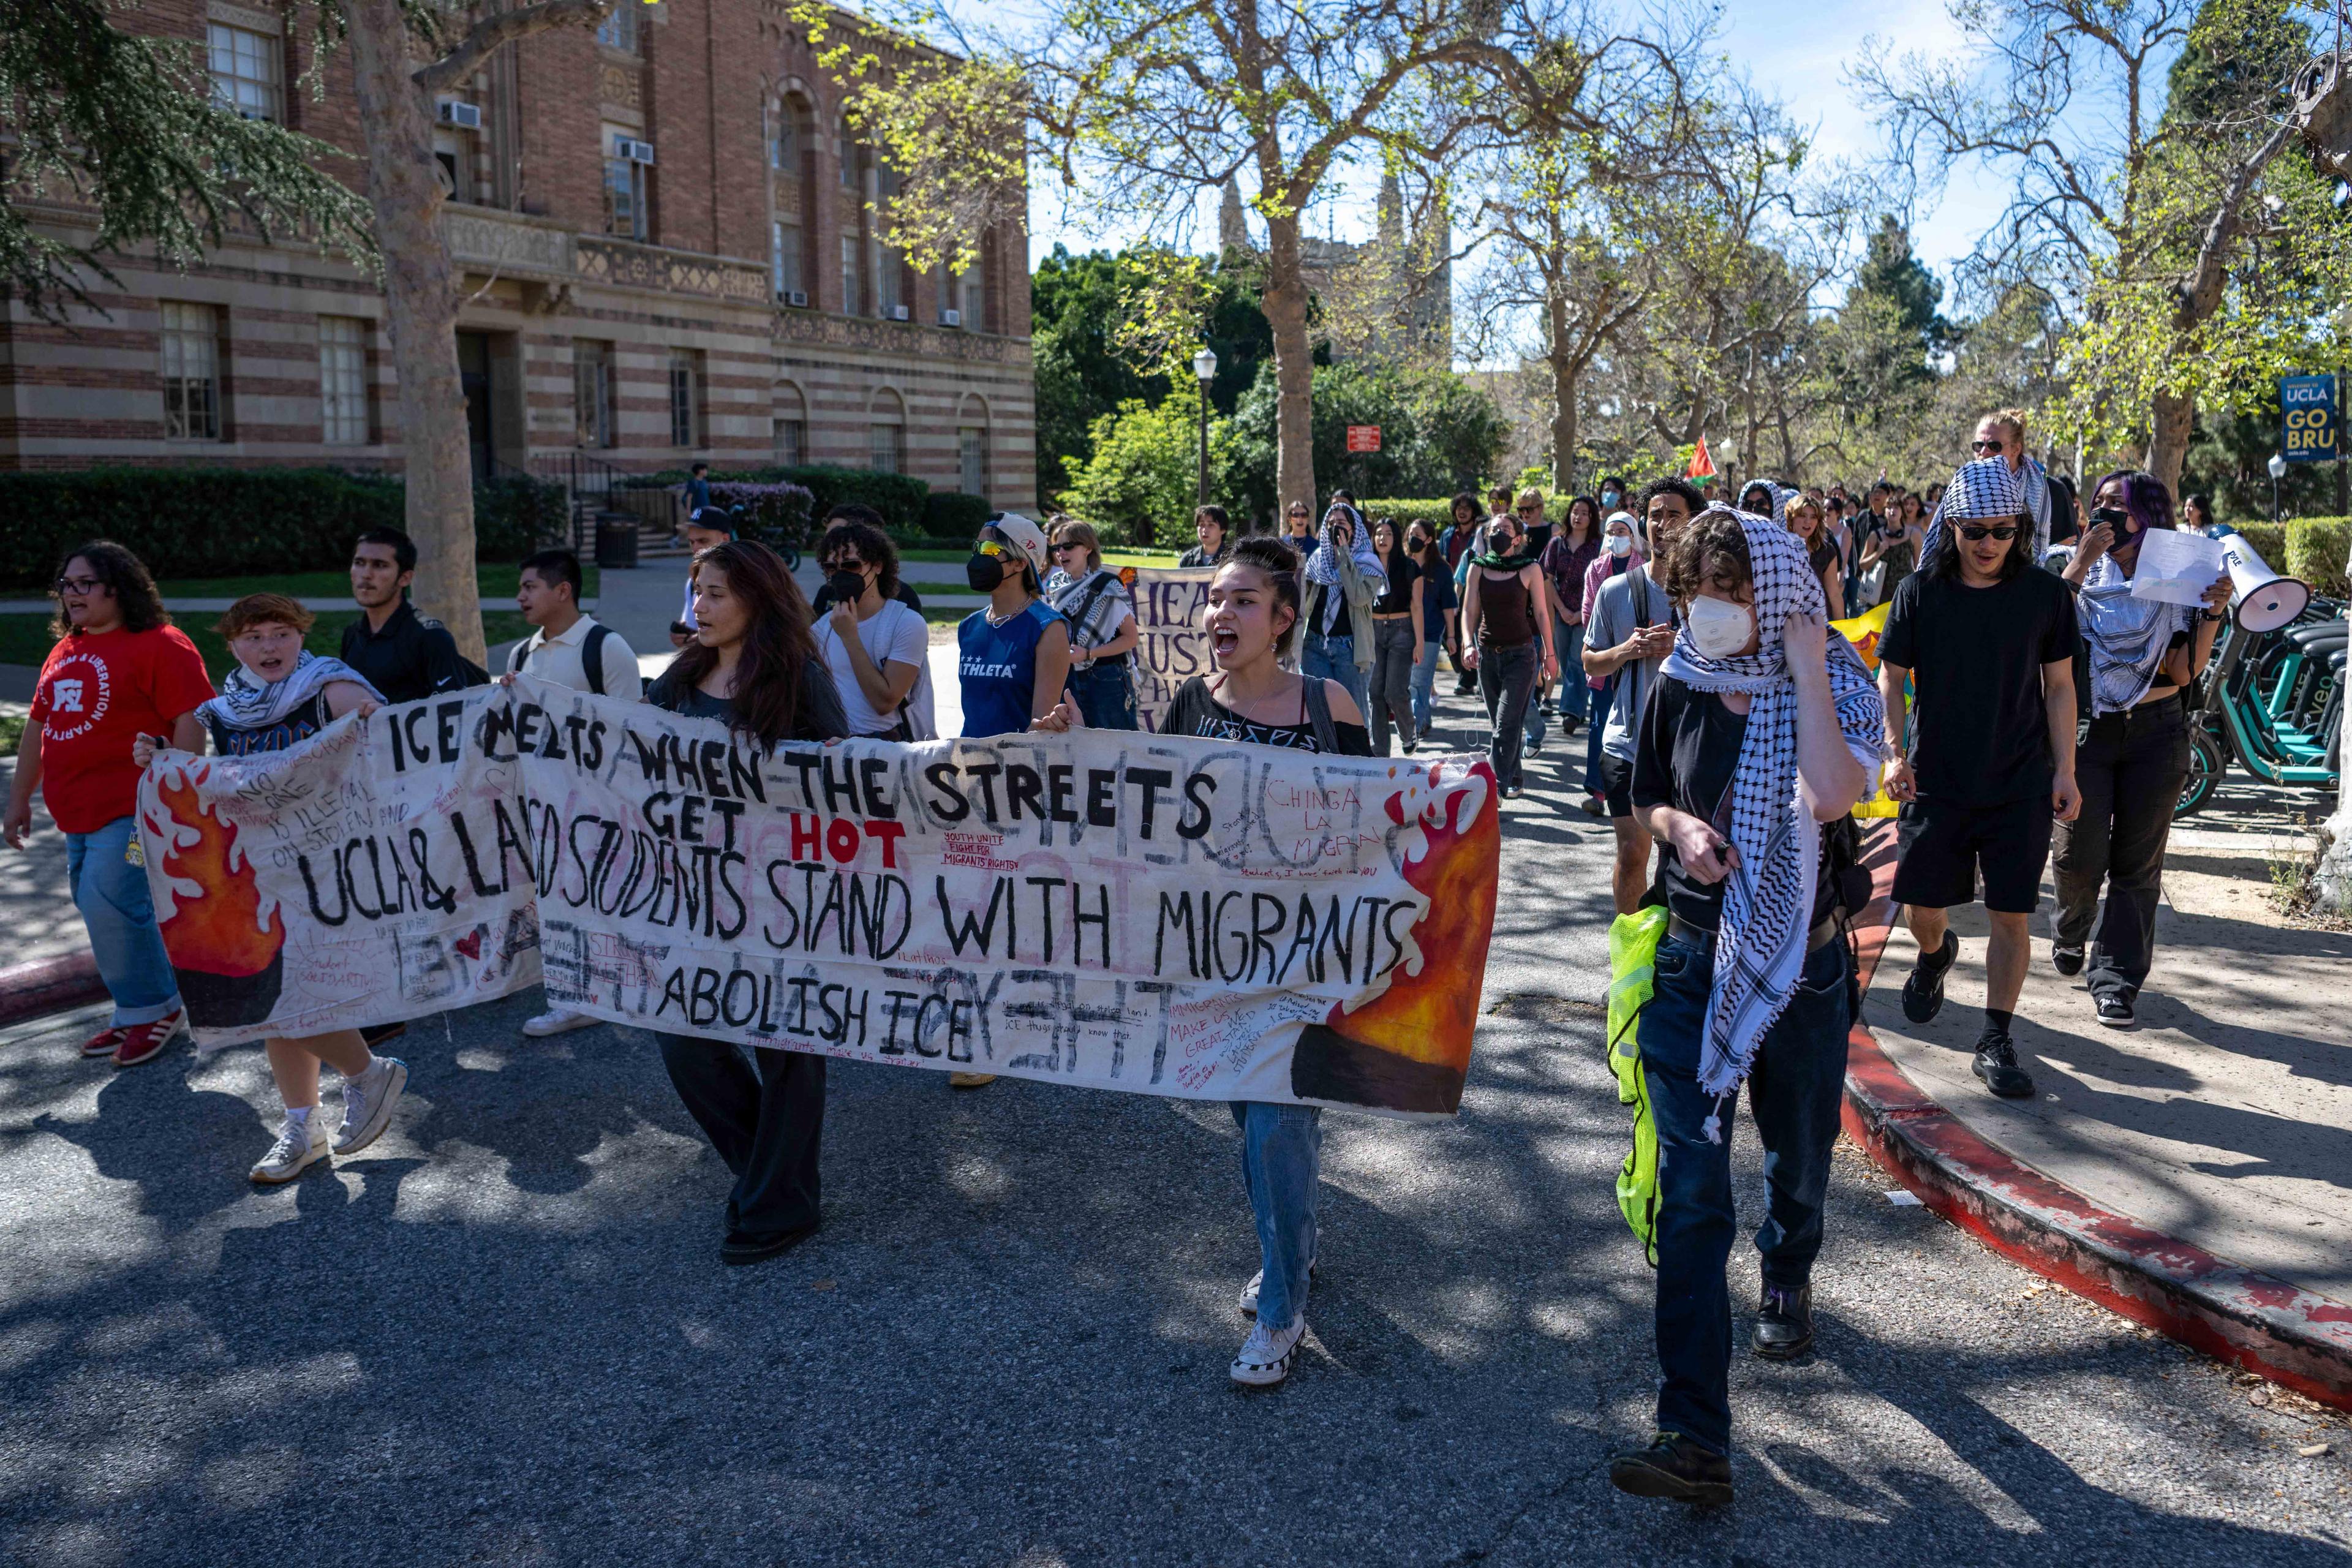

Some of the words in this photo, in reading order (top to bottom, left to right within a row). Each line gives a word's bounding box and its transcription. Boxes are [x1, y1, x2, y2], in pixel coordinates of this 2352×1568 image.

[2287, 388, 2328, 402] UCLA
[2286, 409, 2328, 429] GO
[2287, 429, 2334, 450] BRU
[2230, 550, 2242, 567] PYLE
[88, 654, 110, 721] LIBERATION
[2309, 676, 2333, 714] veo
[52, 720, 93, 741] PARTY
[389, 700, 464, 772] ICE
[483, 700, 606, 771] MELTS
[629, 729, 767, 804] WHEN
[785, 750, 895, 818] THE
[925, 763, 1217, 840] STREETS
[236, 773, 276, 801] NO
[265, 778, 314, 809] ONE
[1267, 780, 1363, 812] CHINGA
[294, 776, 376, 827] ILLEGAL
[643, 791, 745, 857] GET
[791, 813, 905, 869] HOT
[1305, 812, 1332, 830] LA
[944, 832, 973, 842] YOUTH
[977, 834, 1004, 845] UNITE
[950, 843, 973, 853] FIGHT
[978, 845, 990, 855] FOR
[273, 841, 301, 868] ON
[988, 859, 1019, 871] RIGHTS!
[563, 814, 745, 940] STUDENTS
[764, 859, 911, 960] STAND
[936, 875, 1110, 968] WITH
[1154, 890, 1417, 987] MIGRANTS
[655, 967, 869, 1046] ABOLISH
[880, 990, 974, 1063] ICE
[1126, 1007, 1152, 1018] land.
[1169, 993, 1244, 1018] IMMIGRANTS
[1027, 1020, 1050, 1033] thugs
[1113, 1029, 1131, 1040] that.
[1170, 1019, 1208, 1042] MAKE
[1214, 1011, 1230, 1024] US
[1186, 1031, 1224, 1057] GREAT
